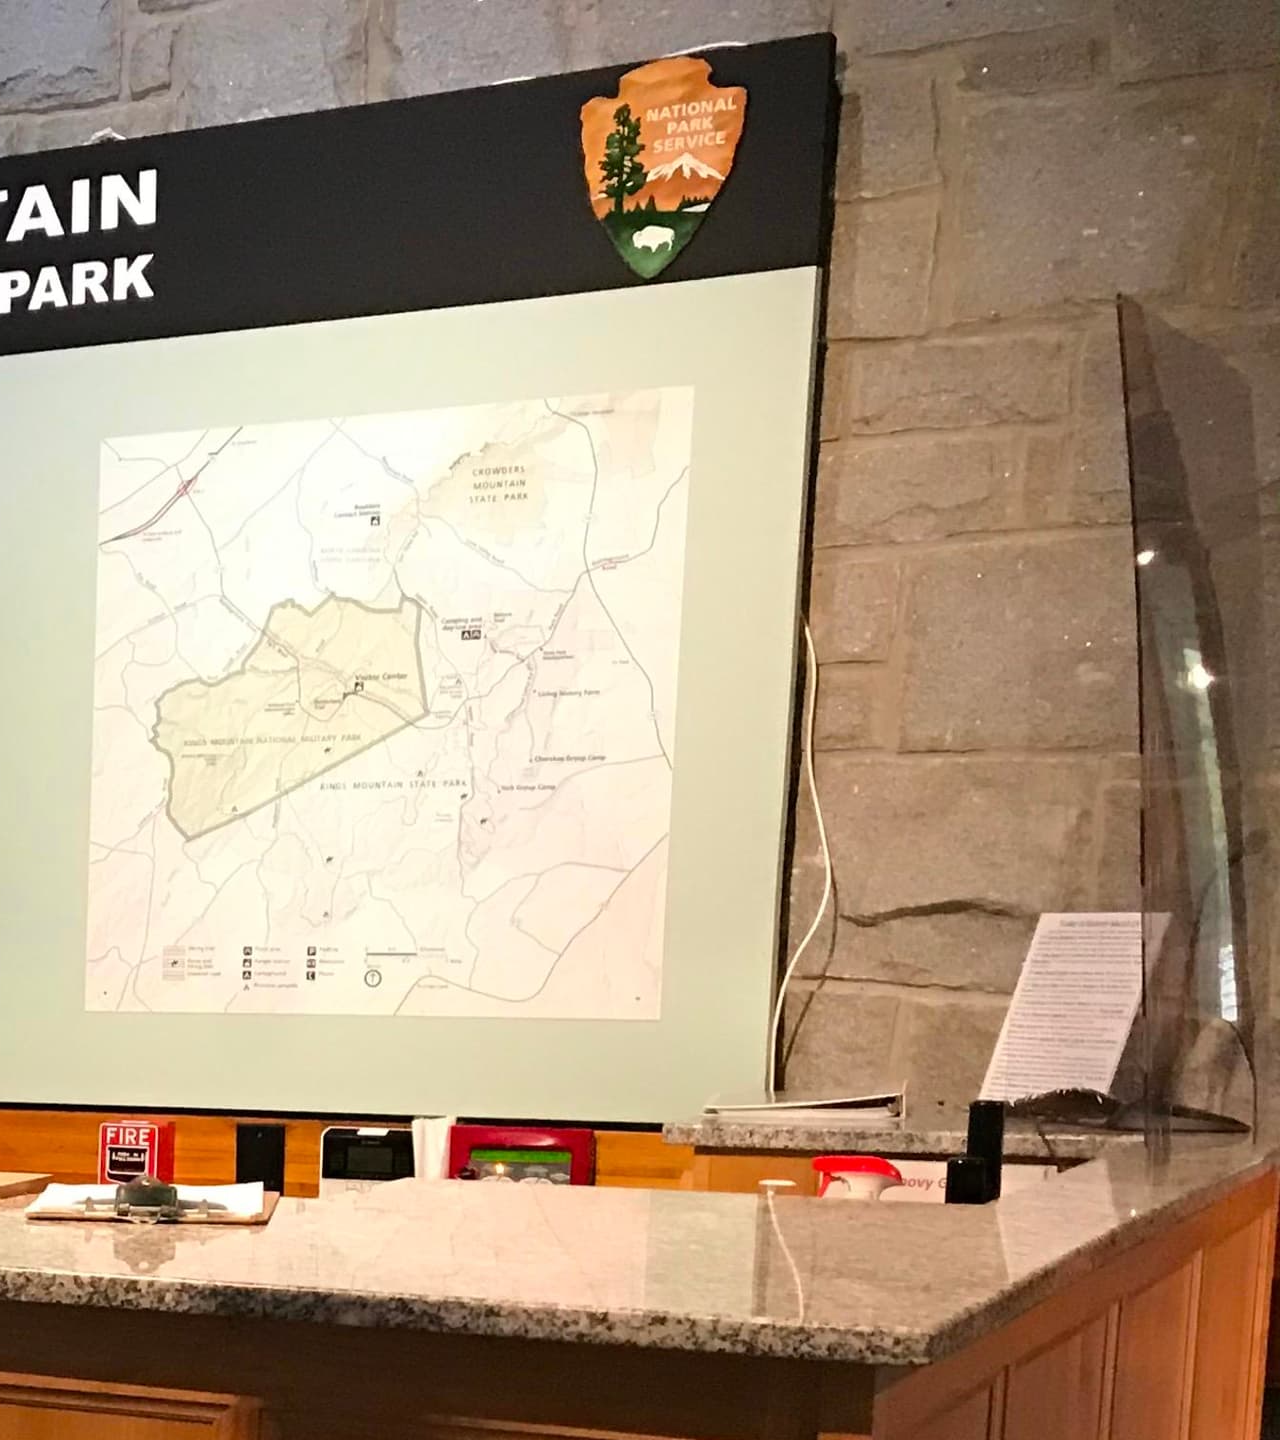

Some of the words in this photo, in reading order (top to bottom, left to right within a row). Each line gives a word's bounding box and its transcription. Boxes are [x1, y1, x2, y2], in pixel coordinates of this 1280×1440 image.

[646, 96, 737, 122] NATIONAL
[666, 116, 713, 135] PARK
[653, 131, 727, 154] SERVICE
[472, 465, 526, 477] CROWDERS
[473, 479, 527, 491] MOUNTAIN
[469, 494, 497, 504] STATE
[504, 492, 529, 502] PARK
[382, 672, 407, 680] Center
[183, 738, 208, 747] KINGS
[210, 736, 255, 746] MOUNTAIN
[256, 735, 296, 745] NATIONAL
[300, 733, 338, 744] MILITARY
[341, 733, 362, 743] PARK
[320, 782, 347, 791] KINGS
[353, 780, 404, 790] MOUNTAIN
[409, 779, 437, 789] STATE
[443, 779, 467, 788] PARK
[106, 1127, 151, 1146] FIRE
